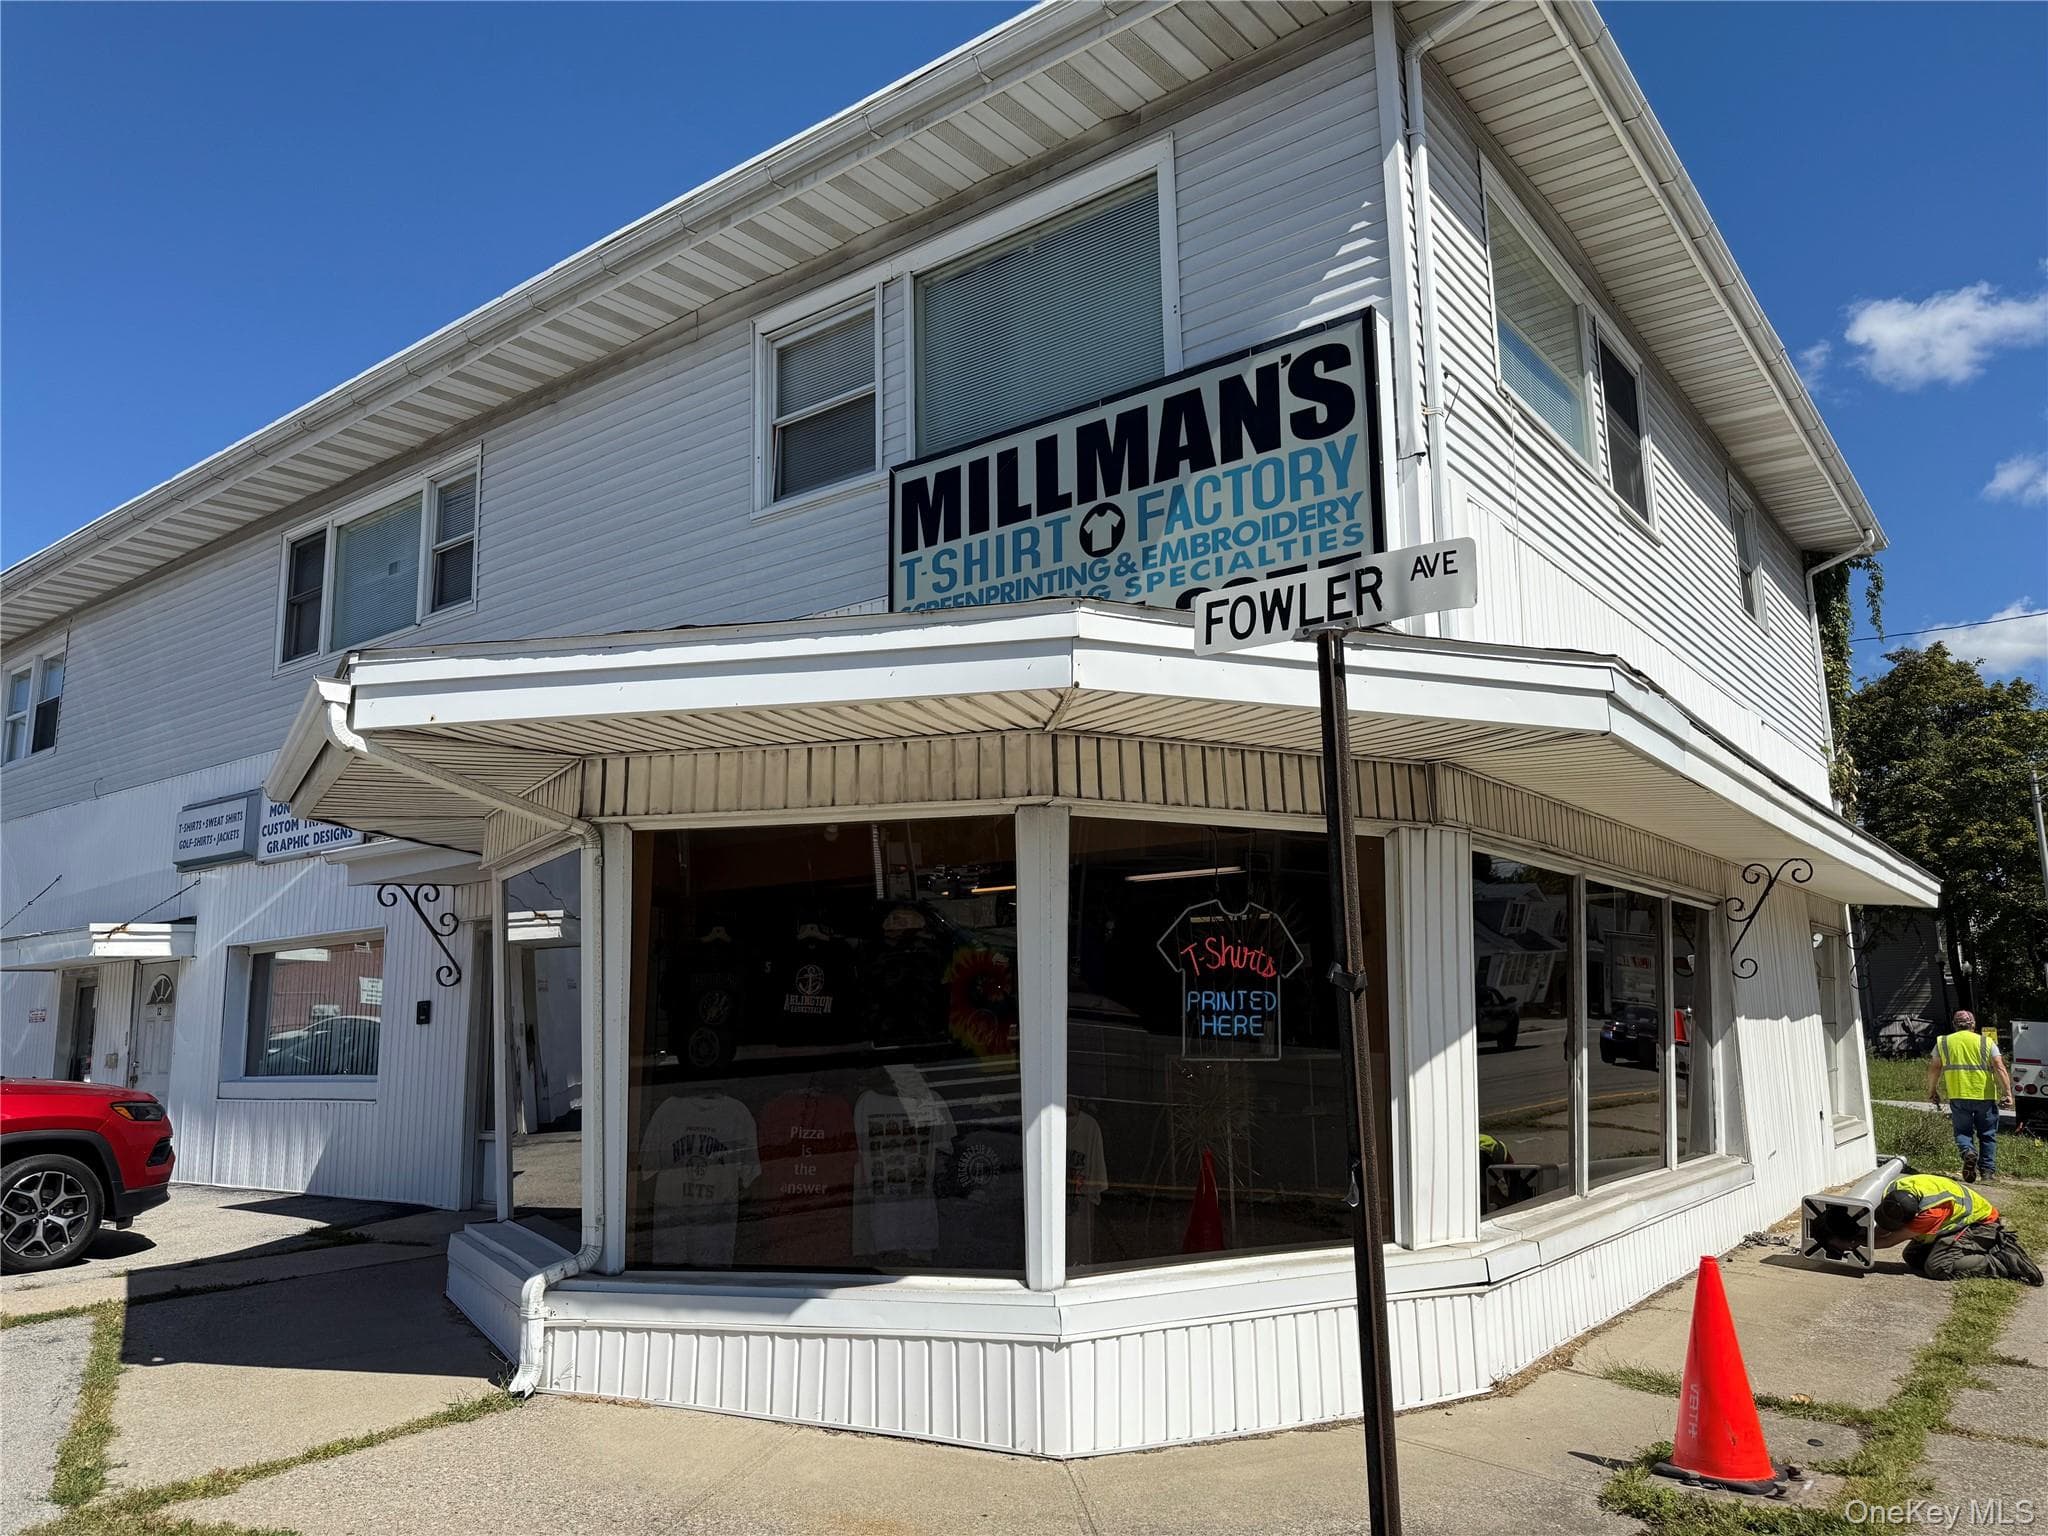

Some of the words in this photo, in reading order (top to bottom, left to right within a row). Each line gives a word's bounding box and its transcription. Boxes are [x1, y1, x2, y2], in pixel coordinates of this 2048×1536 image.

[901, 342, 1356, 554] MILLMAN'S
[900, 515, 1071, 600] T-SHIRT
[1137, 434, 1359, 541] FACTORY
[1114, 552, 1137, 577] &
[1142, 491, 1363, 570] EMBROIDERY
[1125, 523, 1364, 597] SPECIALTIES
[1205, 566, 1383, 645] FOWLER
[1410, 550, 1458, 581] AVE
[178, 820, 202, 833] T-SHIRTS
[205, 815, 224, 828] SWEAT
[225, 811, 243, 824] SHIRTS
[261, 818, 299, 837] CUSTOM
[178, 835, 213, 850] GOLF-SHIRTS
[216, 829, 240, 846] JACKETS
[266, 834, 309, 853] GRAPHIC
[313, 828, 353, 845] DESIGNS
[1180, 936, 1276, 977] T-Shirts
[1186, 990, 1277, 1011] PRINTED
[1201, 1014, 1264, 1036] HERE
[790, 1126, 825, 1139] Pizza
[801, 1144, 812, 1158] is
[794, 1163, 817, 1176] the
[779, 1183, 828, 1195] answer
